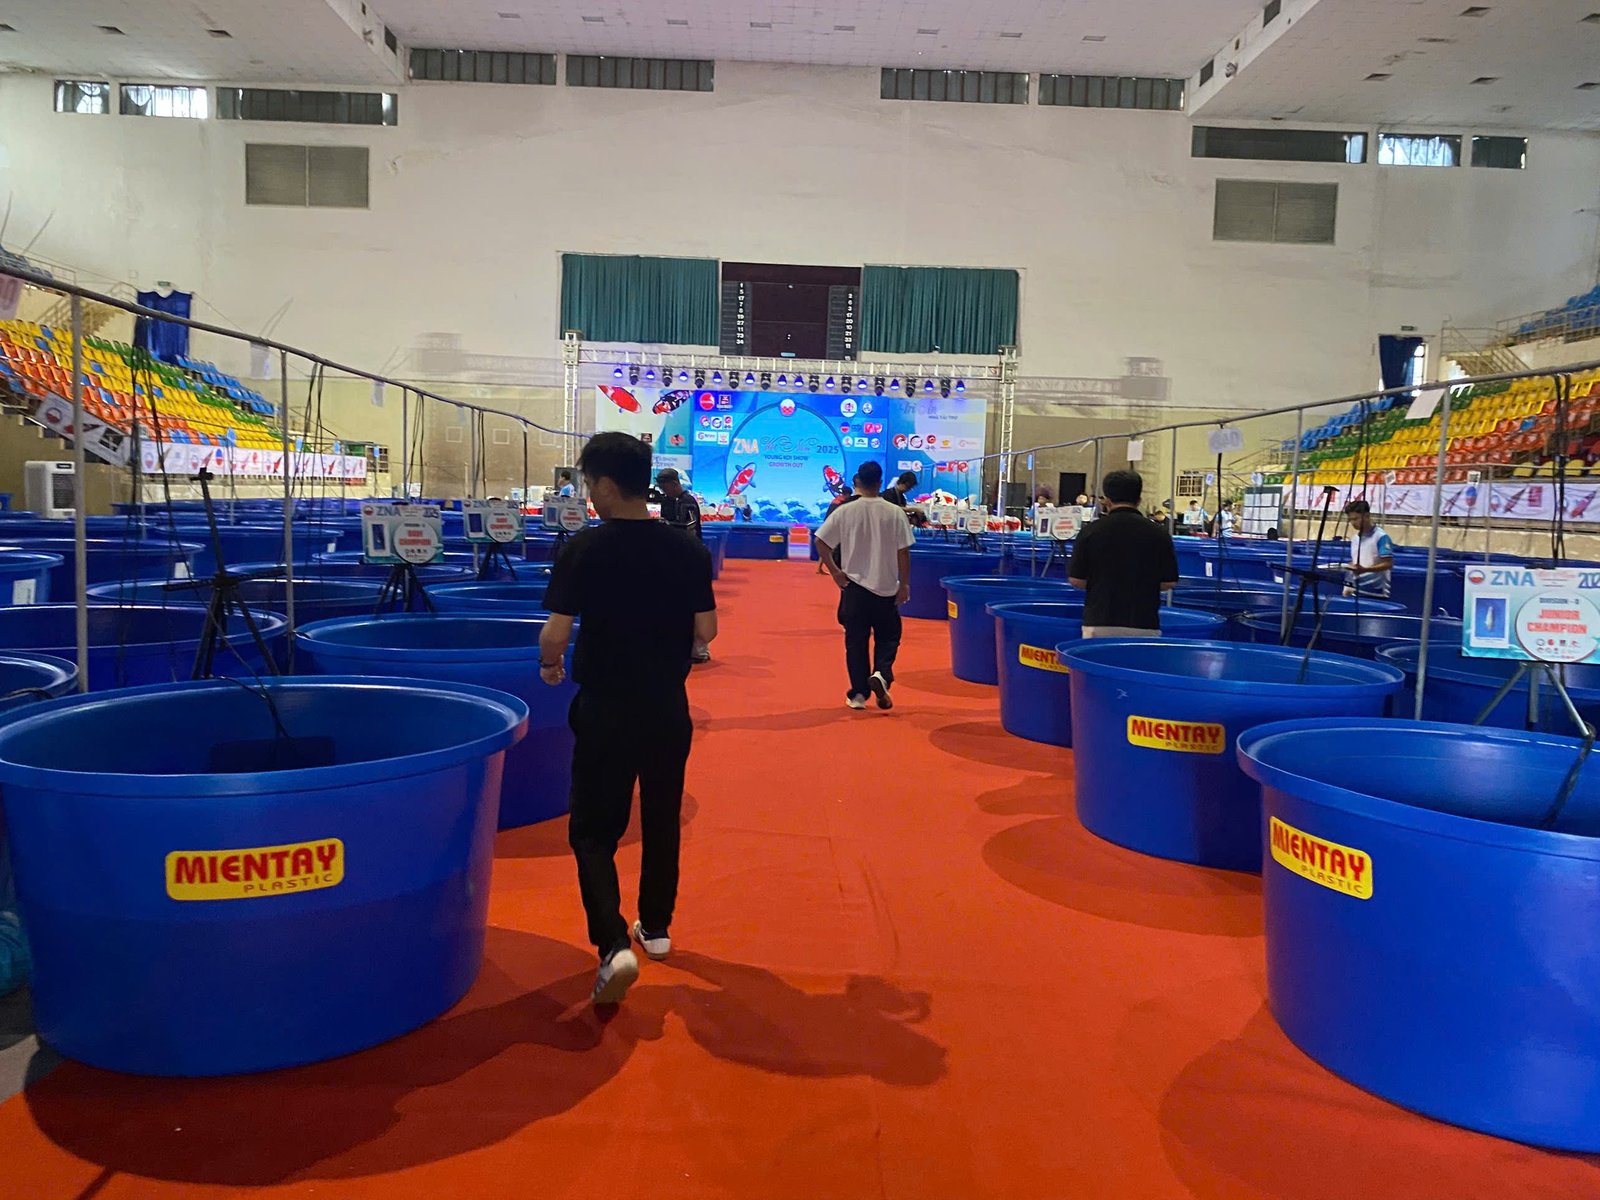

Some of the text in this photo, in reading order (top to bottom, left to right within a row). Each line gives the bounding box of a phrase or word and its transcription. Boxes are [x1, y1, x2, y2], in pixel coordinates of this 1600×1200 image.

[733, 438, 760, 454] ZNA
[816, 445, 839, 454] 2025
[375, 506, 401, 517] ZNA
[1491, 570, 1535, 587] ZNA
[1022, 646, 1060, 664] MIENT
[1132, 719, 1220, 743] MIENTAY
[1273, 822, 1365, 882] MIENTAY
[174, 843, 337, 884] MIENTAY
[243, 873, 334, 893] PLASTIC
[1301, 864, 1364, 894] PLASTIC
